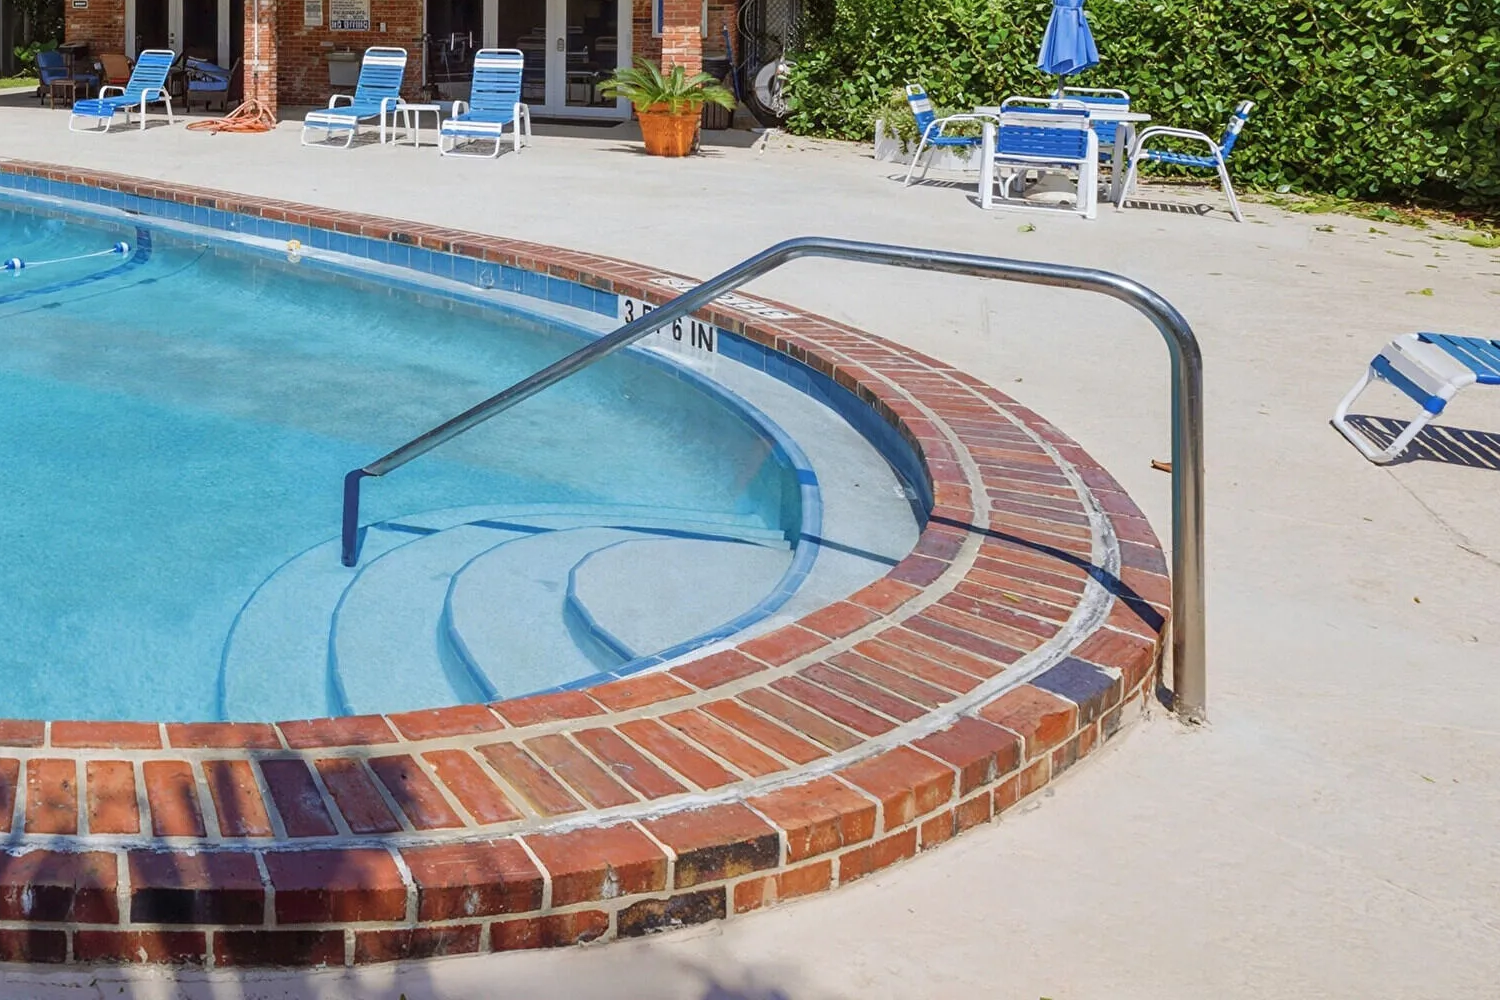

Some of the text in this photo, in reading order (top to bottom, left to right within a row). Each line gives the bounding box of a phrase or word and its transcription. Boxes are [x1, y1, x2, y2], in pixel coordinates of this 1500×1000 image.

[624, 300, 634, 324] 3
[672, 317, 682, 341] 6
[691, 320, 713, 353] IN
